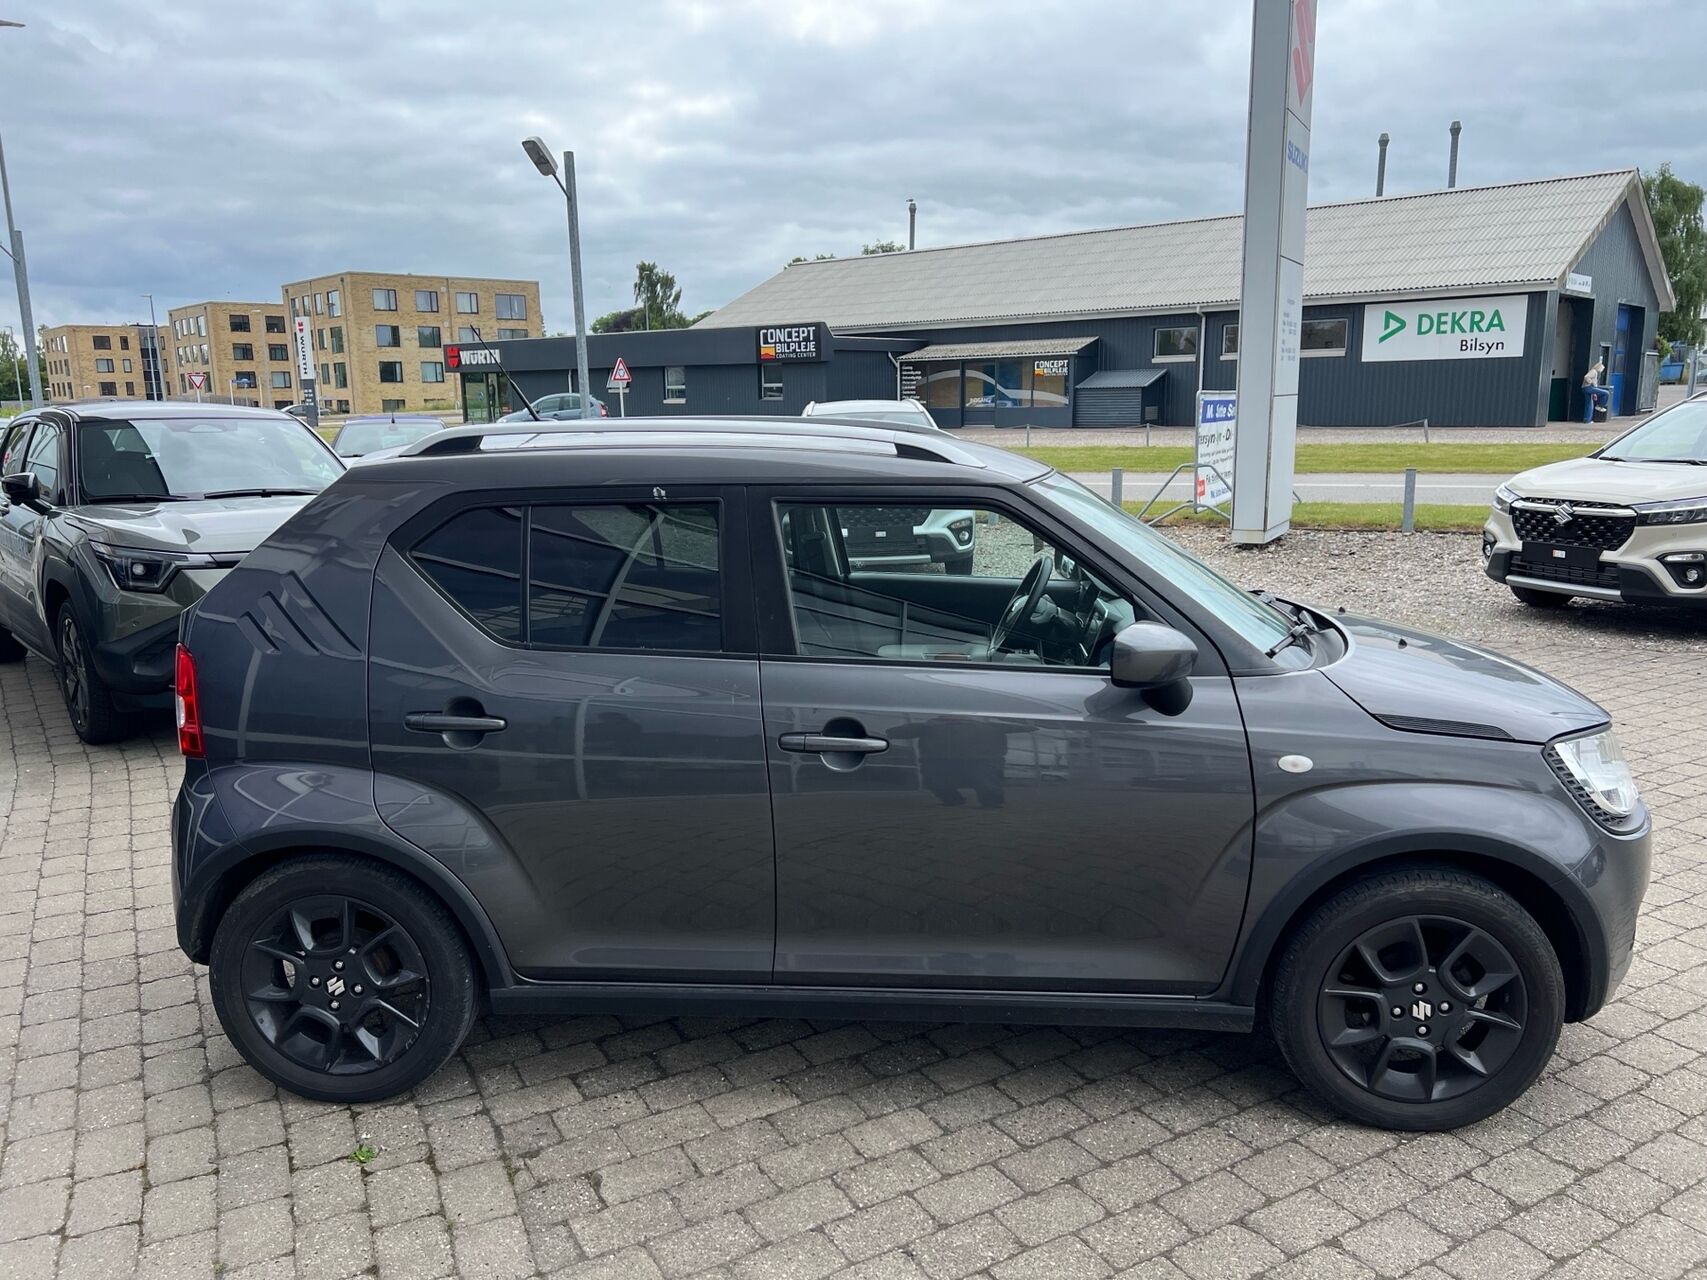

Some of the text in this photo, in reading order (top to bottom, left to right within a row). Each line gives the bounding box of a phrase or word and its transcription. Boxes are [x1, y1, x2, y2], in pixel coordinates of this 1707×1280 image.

[1287, 140, 1309, 174] SUZUKI
[1417, 309, 1505, 335] DEKRA
[760, 326, 816, 347] CONCEPT
[775, 341, 816, 353] BILPLEJE
[1460, 338, 1505, 354] Bilsyn
[460, 349, 501, 365] WÜRTH
[1034, 359, 1069, 371] CONCEPT
